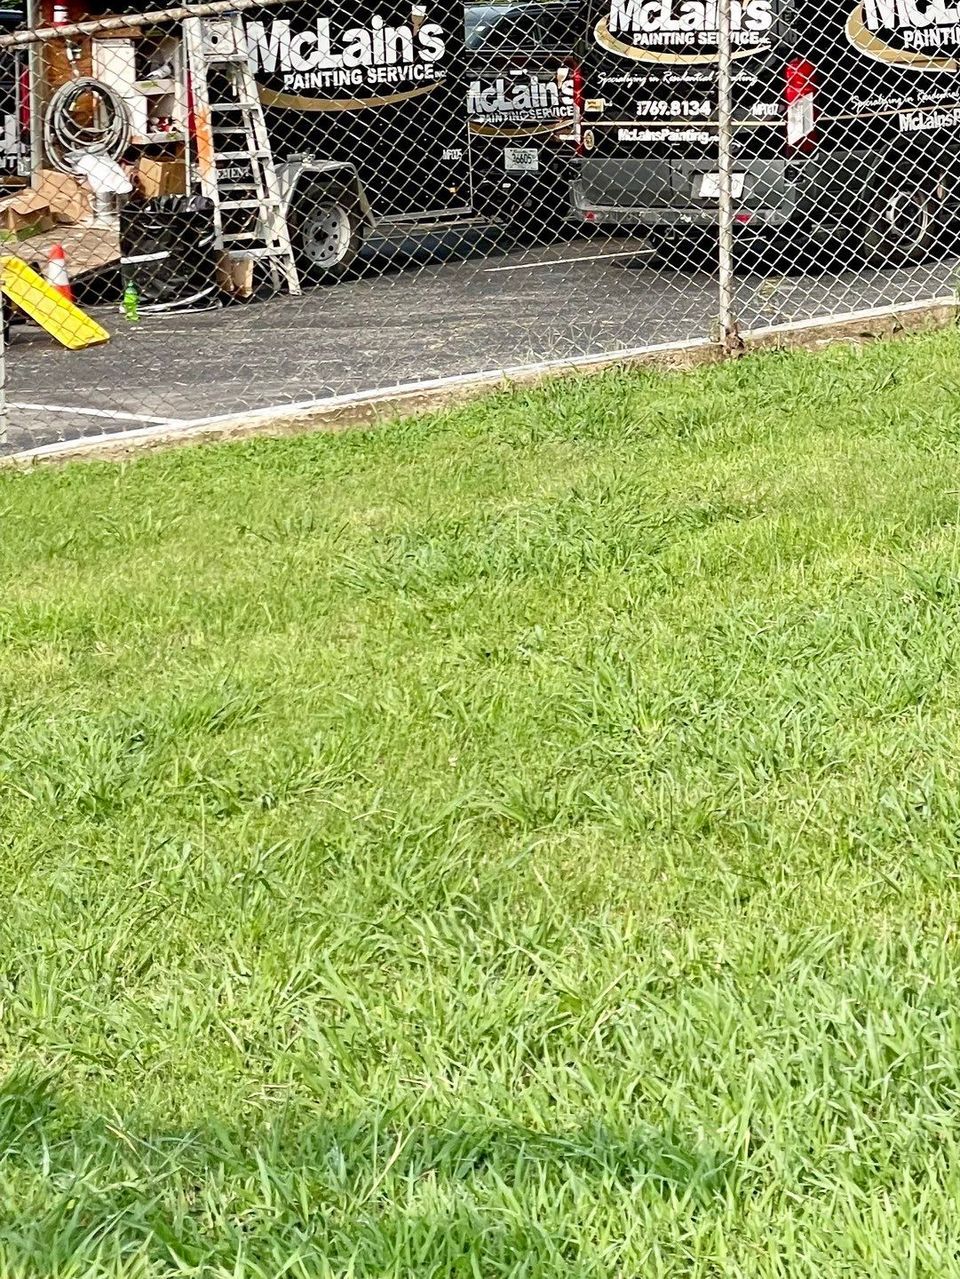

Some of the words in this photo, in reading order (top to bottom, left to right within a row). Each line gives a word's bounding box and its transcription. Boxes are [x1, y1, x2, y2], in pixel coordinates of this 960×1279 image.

[246, 14, 446, 74] McLain's
[633, 31, 694, 45] PAINTING
[697, 31, 759, 45] SEVICE
[284, 70, 363, 90] PAINTING
[367, 63, 434, 82] SERVICE
[715, 72, 758, 86] inting
[530, 105, 574, 119] SERVICE
